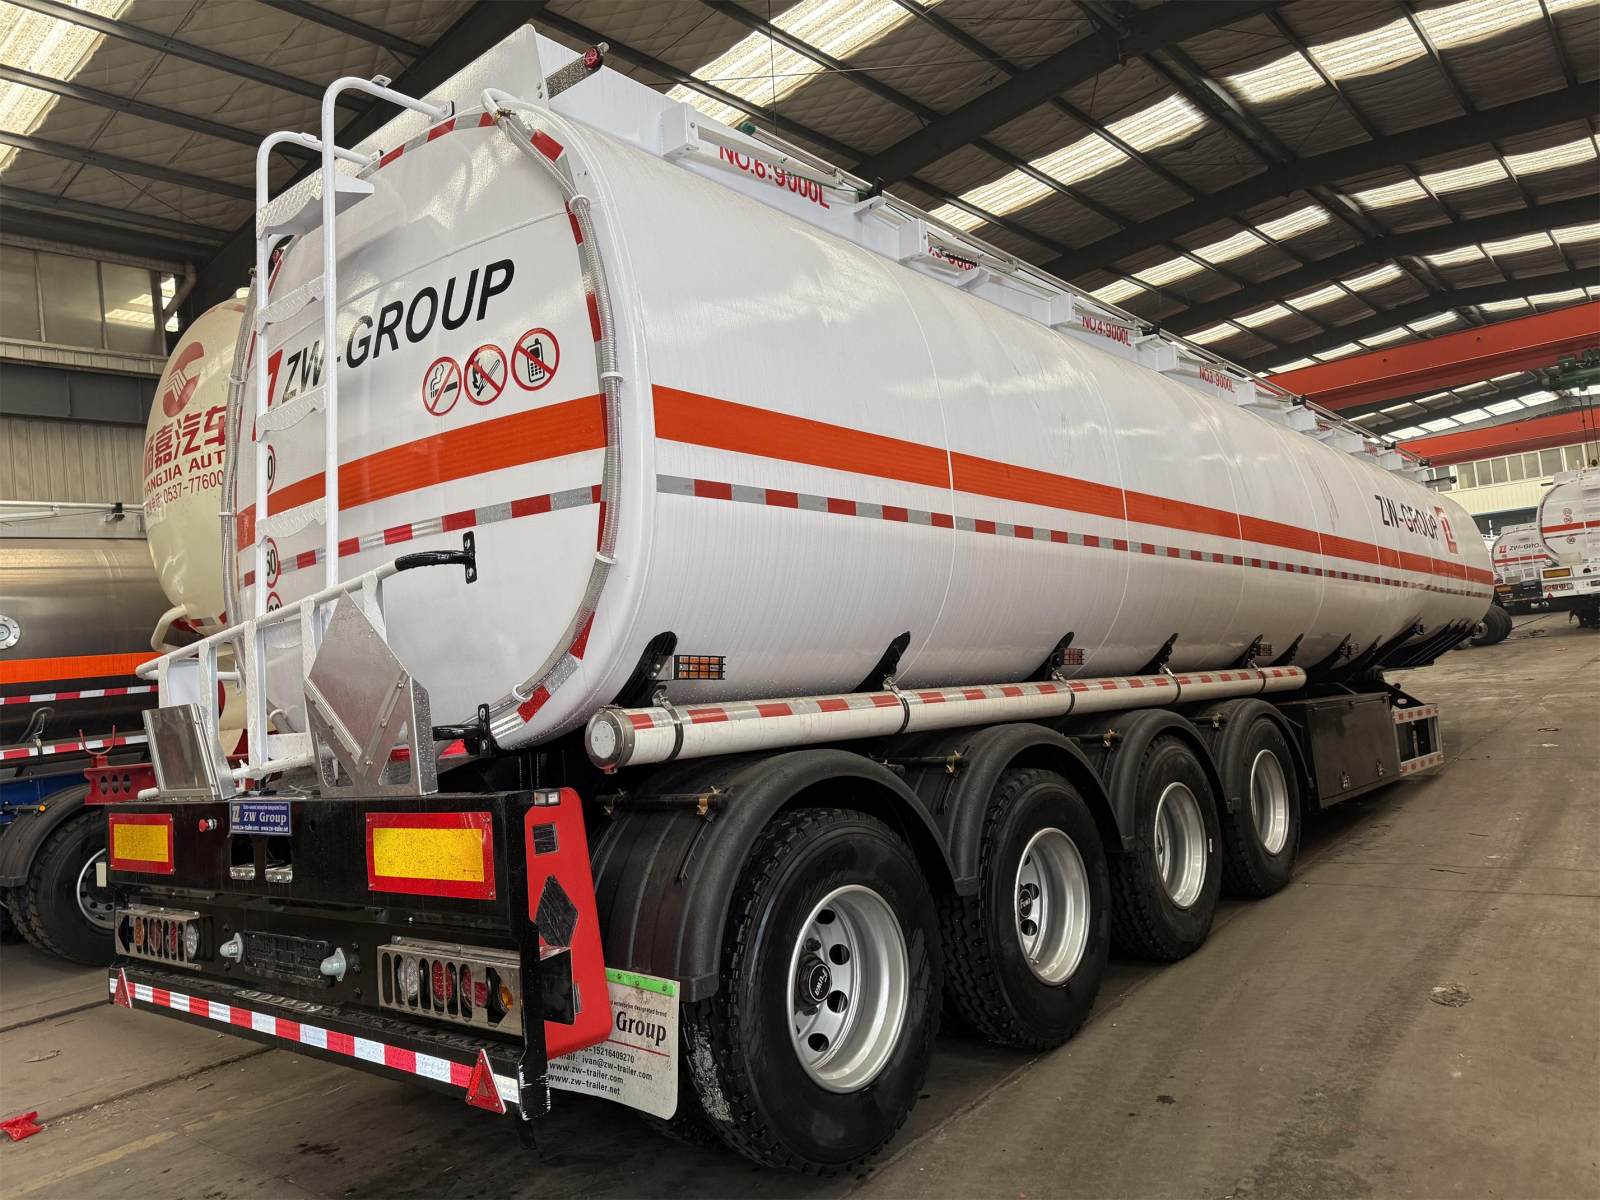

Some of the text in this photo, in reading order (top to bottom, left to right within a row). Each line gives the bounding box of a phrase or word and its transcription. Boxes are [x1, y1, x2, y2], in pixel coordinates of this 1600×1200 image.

[1373, 494, 1439, 541] ZW-GROUP
[1509, 542, 1542, 551] ZW-GRO
[243, 811, 287, 826] ZW Group
[616, 1011, 667, 1047] Group
[580, 1046, 635, 1064] -15216409270
[547, 1073, 620, 1095] www.zw-trailer.net
[549, 1062, 624, 1084] www.zw-trailer.com
